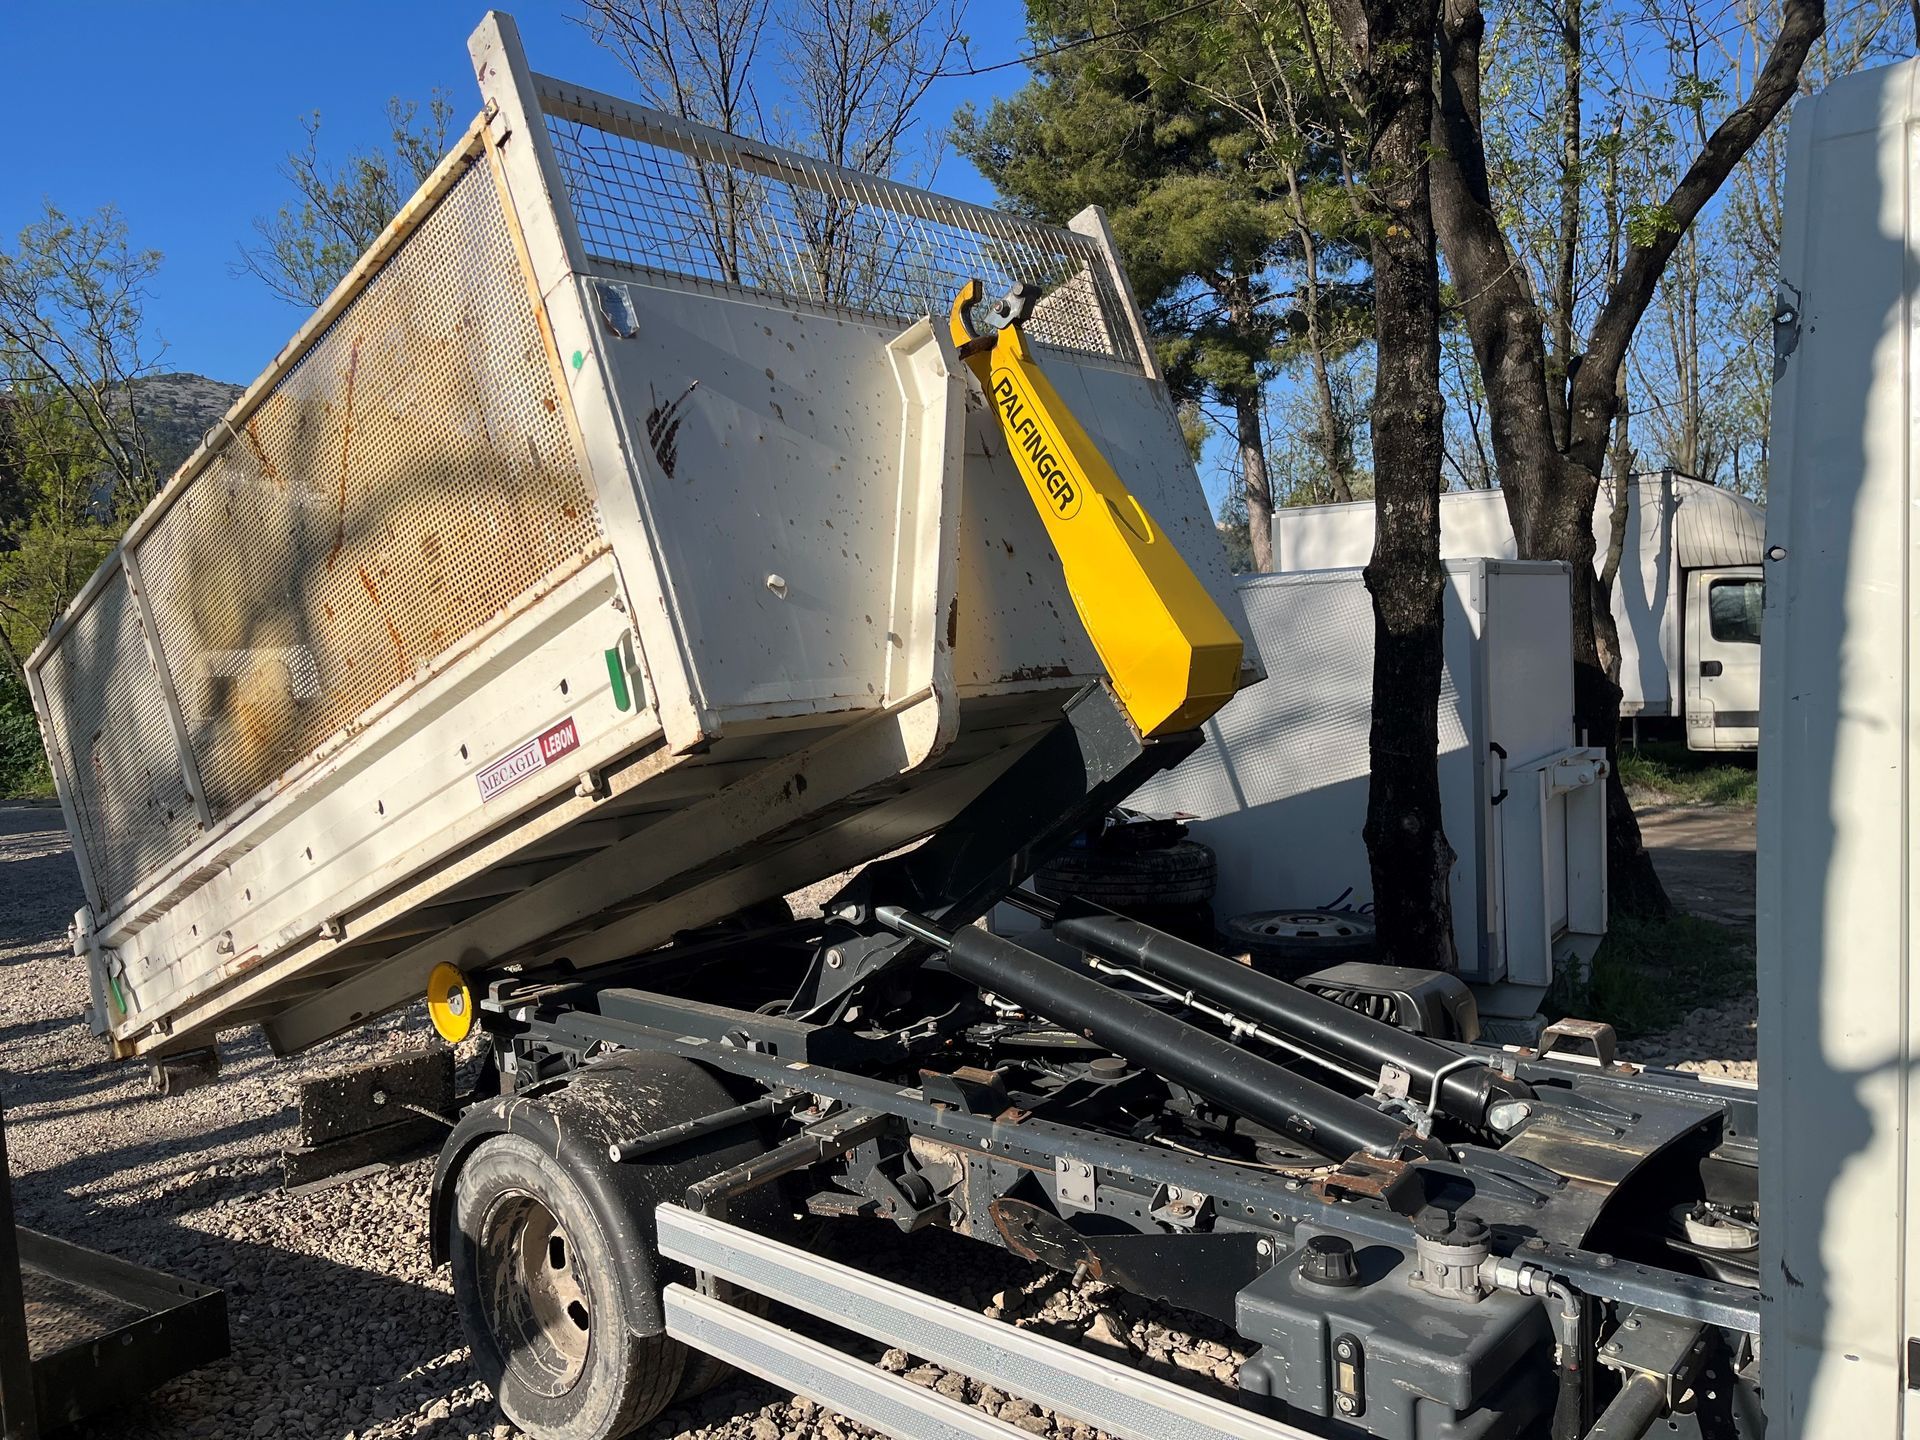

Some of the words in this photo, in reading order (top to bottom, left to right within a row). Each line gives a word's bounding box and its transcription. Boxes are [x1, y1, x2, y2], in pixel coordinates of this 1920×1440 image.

[992, 376, 1075, 512] PALFINGER
[481, 750, 541, 794] MECAGIL
[543, 724, 575, 759] LEBON
